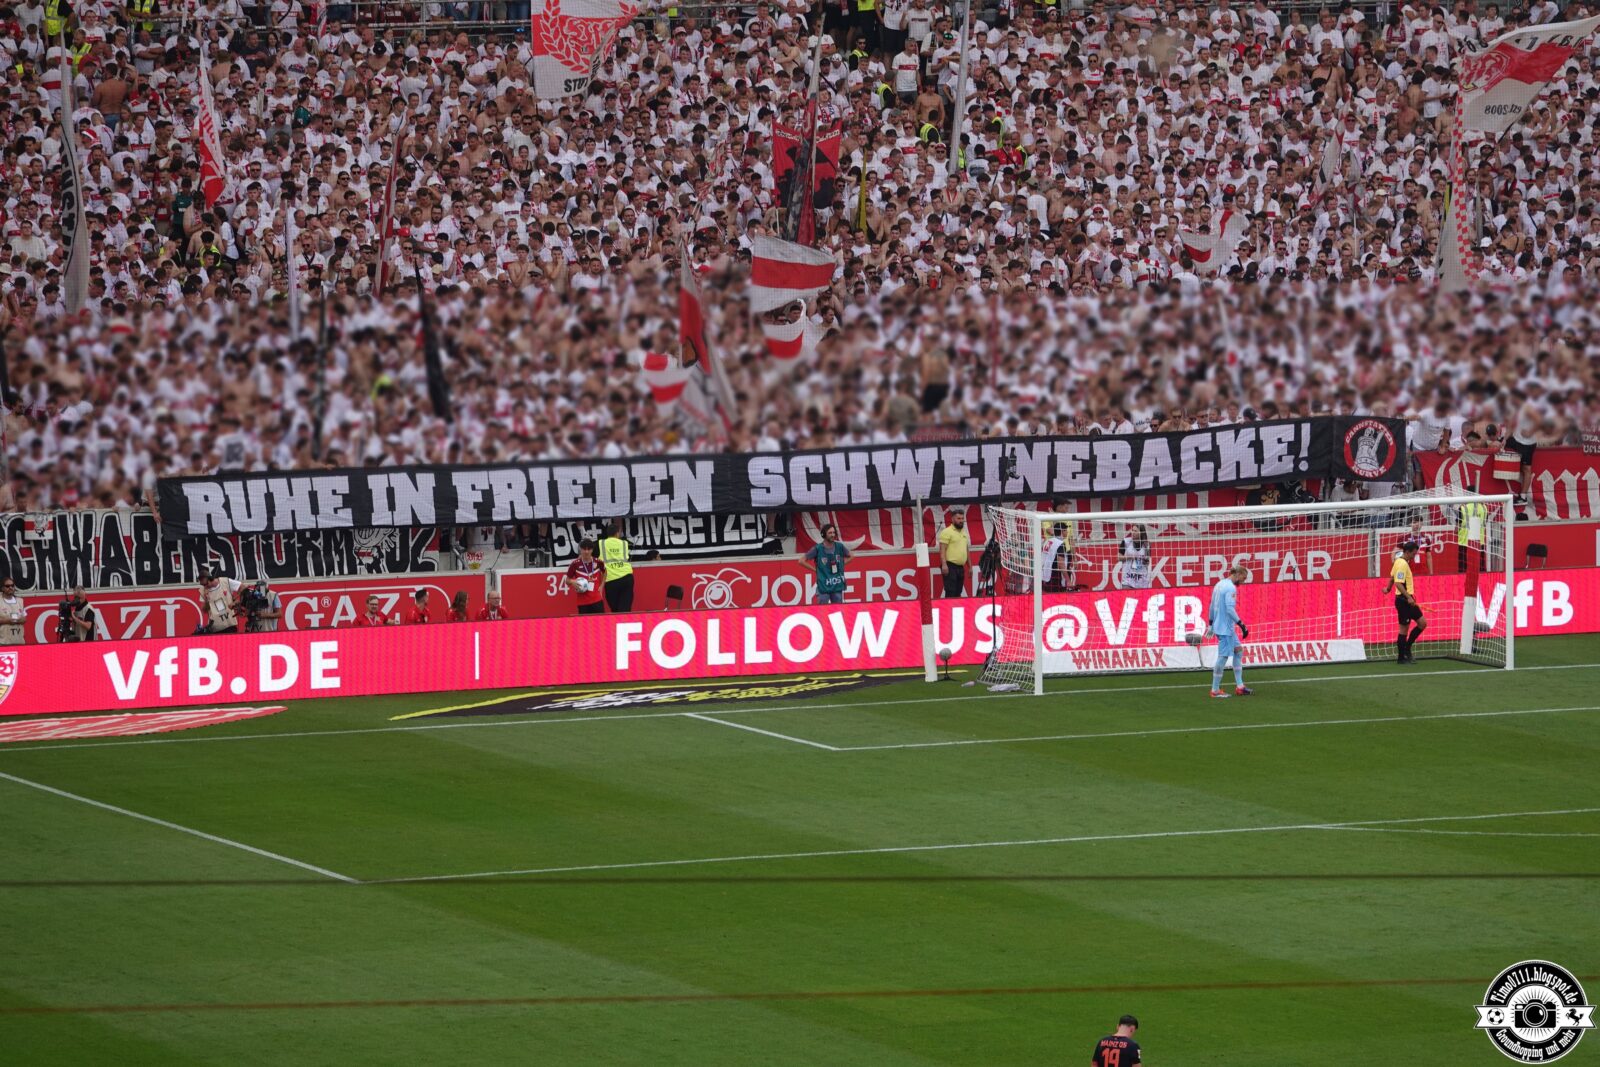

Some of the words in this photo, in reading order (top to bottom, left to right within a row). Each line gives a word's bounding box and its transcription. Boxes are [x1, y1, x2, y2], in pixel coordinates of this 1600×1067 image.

[181, 475, 354, 535] RUHE
[367, 472, 437, 526] IN
[451, 460, 715, 524] FRIEDEN
[747, 423, 1311, 507] SCHWEINEBACKE!
[546, 574, 570, 597] 34
[1475, 578, 1574, 630] VfB
[218, 613, 230, 622] TV
[615, 606, 899, 671] FOLLOW
[932, 604, 1004, 655] US
[1040, 592, 1207, 651] @VfB
[102, 640, 342, 701] VfB.DE
[1071, 648, 1167, 670] WINAMAX
[1102, 1048, 1120, 1067] 19
